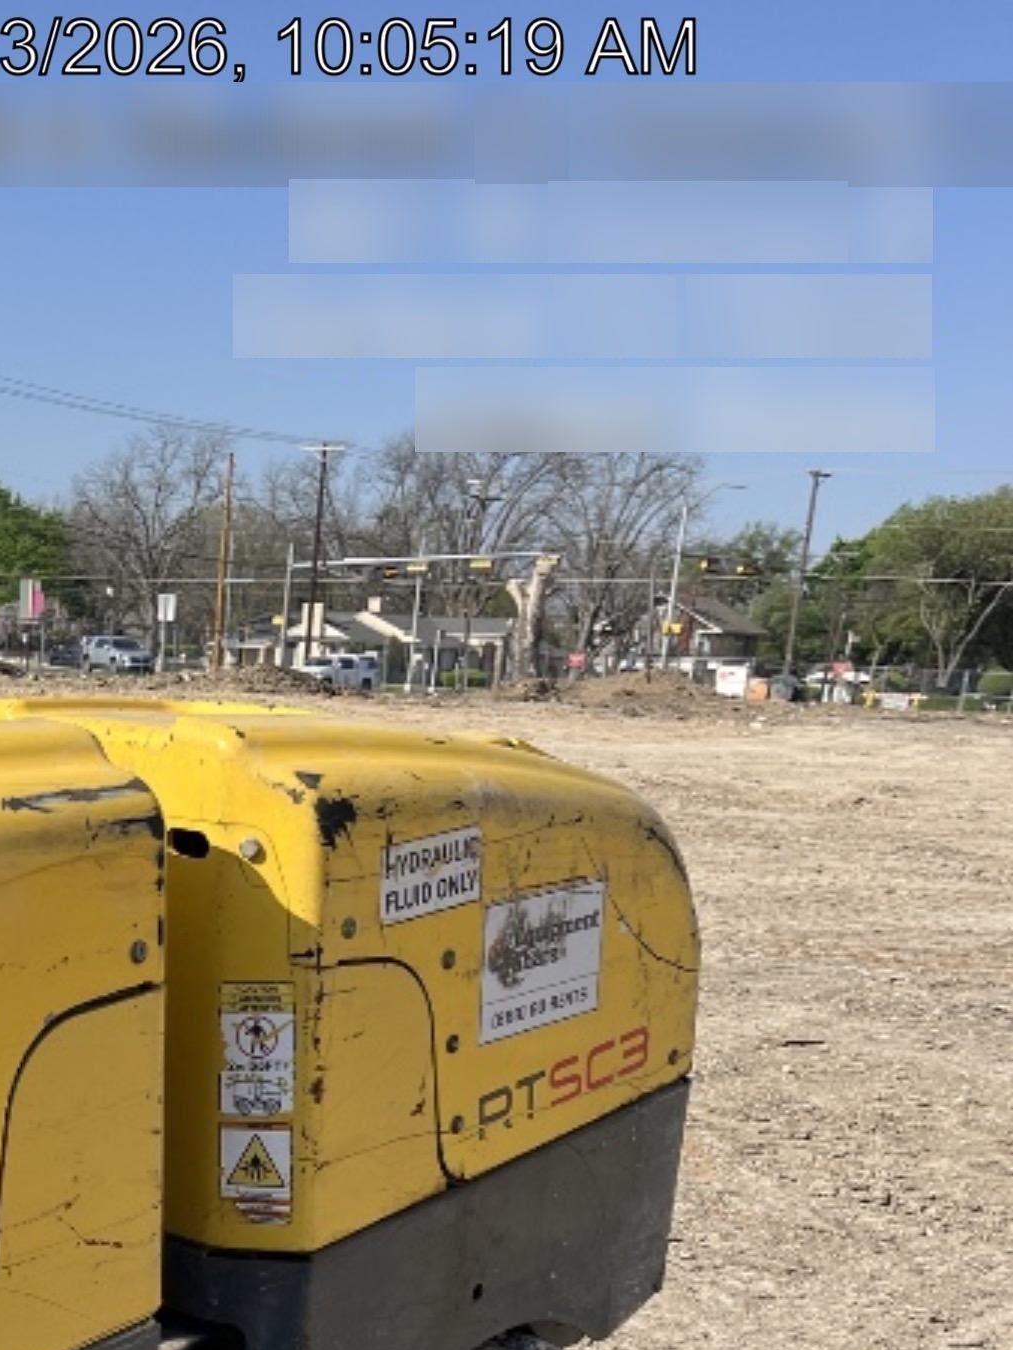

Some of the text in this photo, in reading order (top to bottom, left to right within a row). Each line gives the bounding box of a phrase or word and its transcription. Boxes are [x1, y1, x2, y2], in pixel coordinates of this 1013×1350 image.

[385, 836, 478, 880] HYDRAULIC
[385, 870, 477, 914] FLUID ONLY
